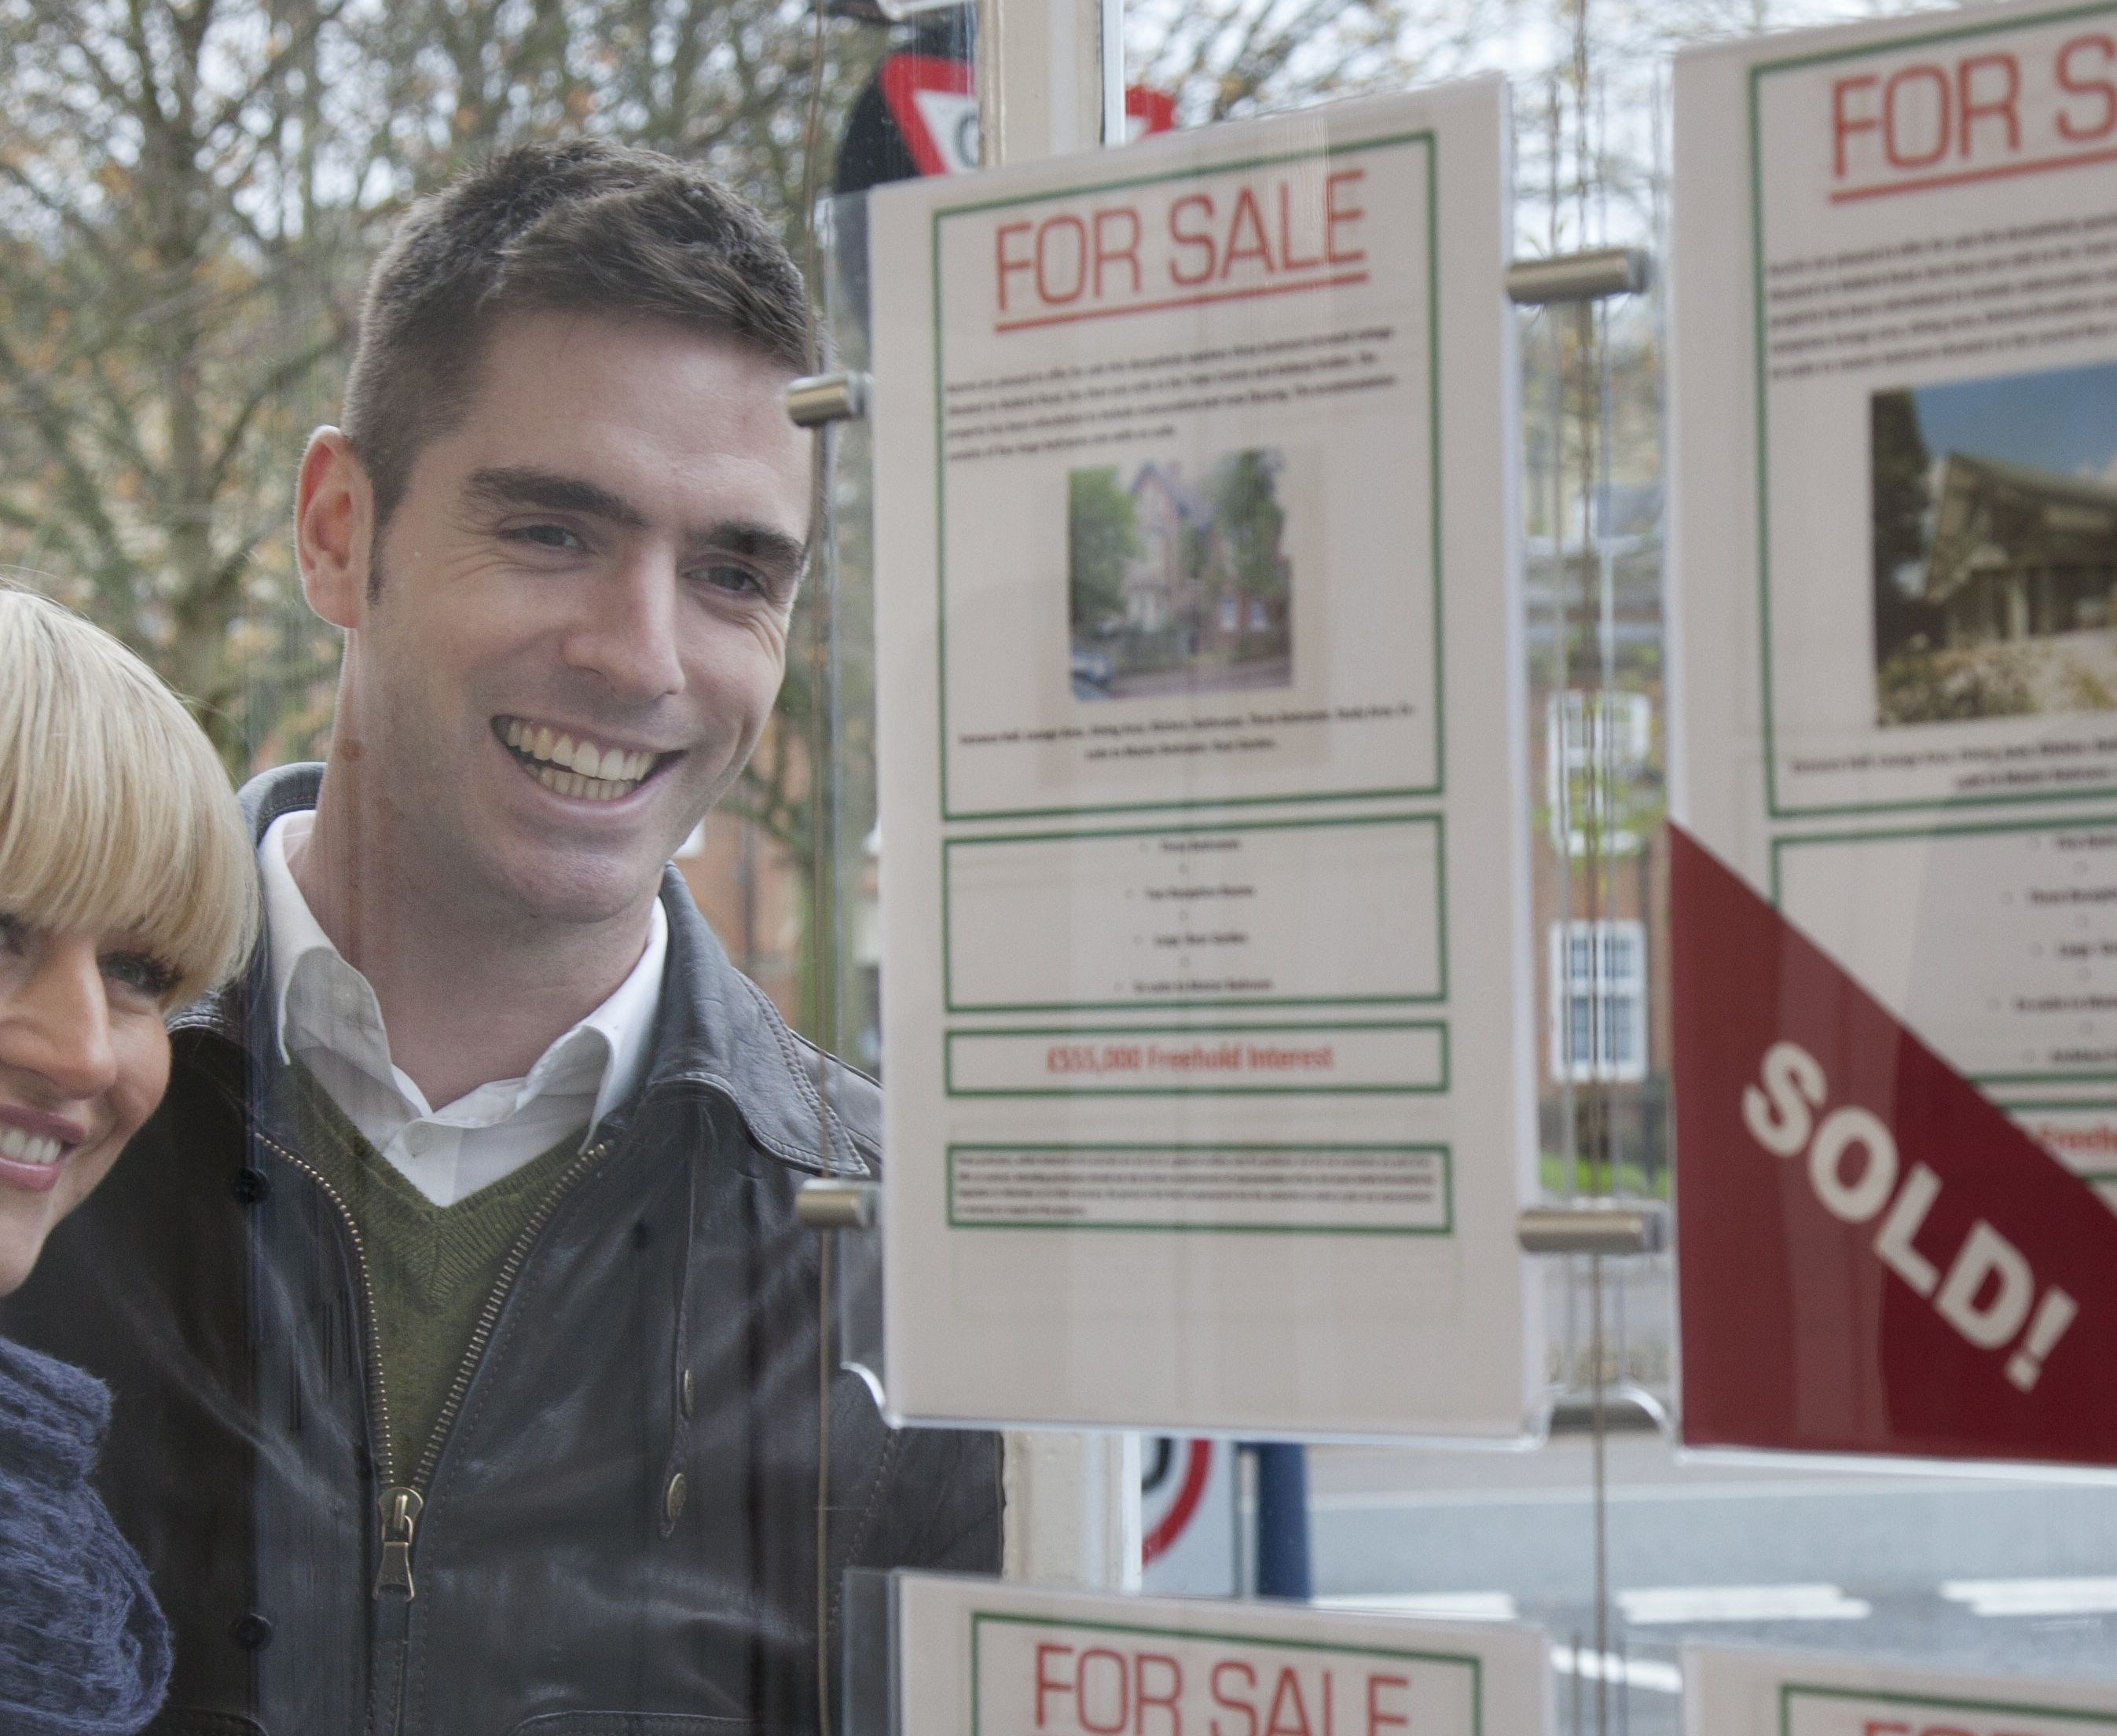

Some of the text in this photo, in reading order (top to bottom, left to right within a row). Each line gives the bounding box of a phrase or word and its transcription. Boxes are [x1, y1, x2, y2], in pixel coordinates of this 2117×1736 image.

[1832, 52, 2021, 180] FOR
[994, 167, 1366, 312] FOR SALE
[1741, 1040, 2079, 1393] SOLD!
[1035, 1642, 1182, 1736] FOR
